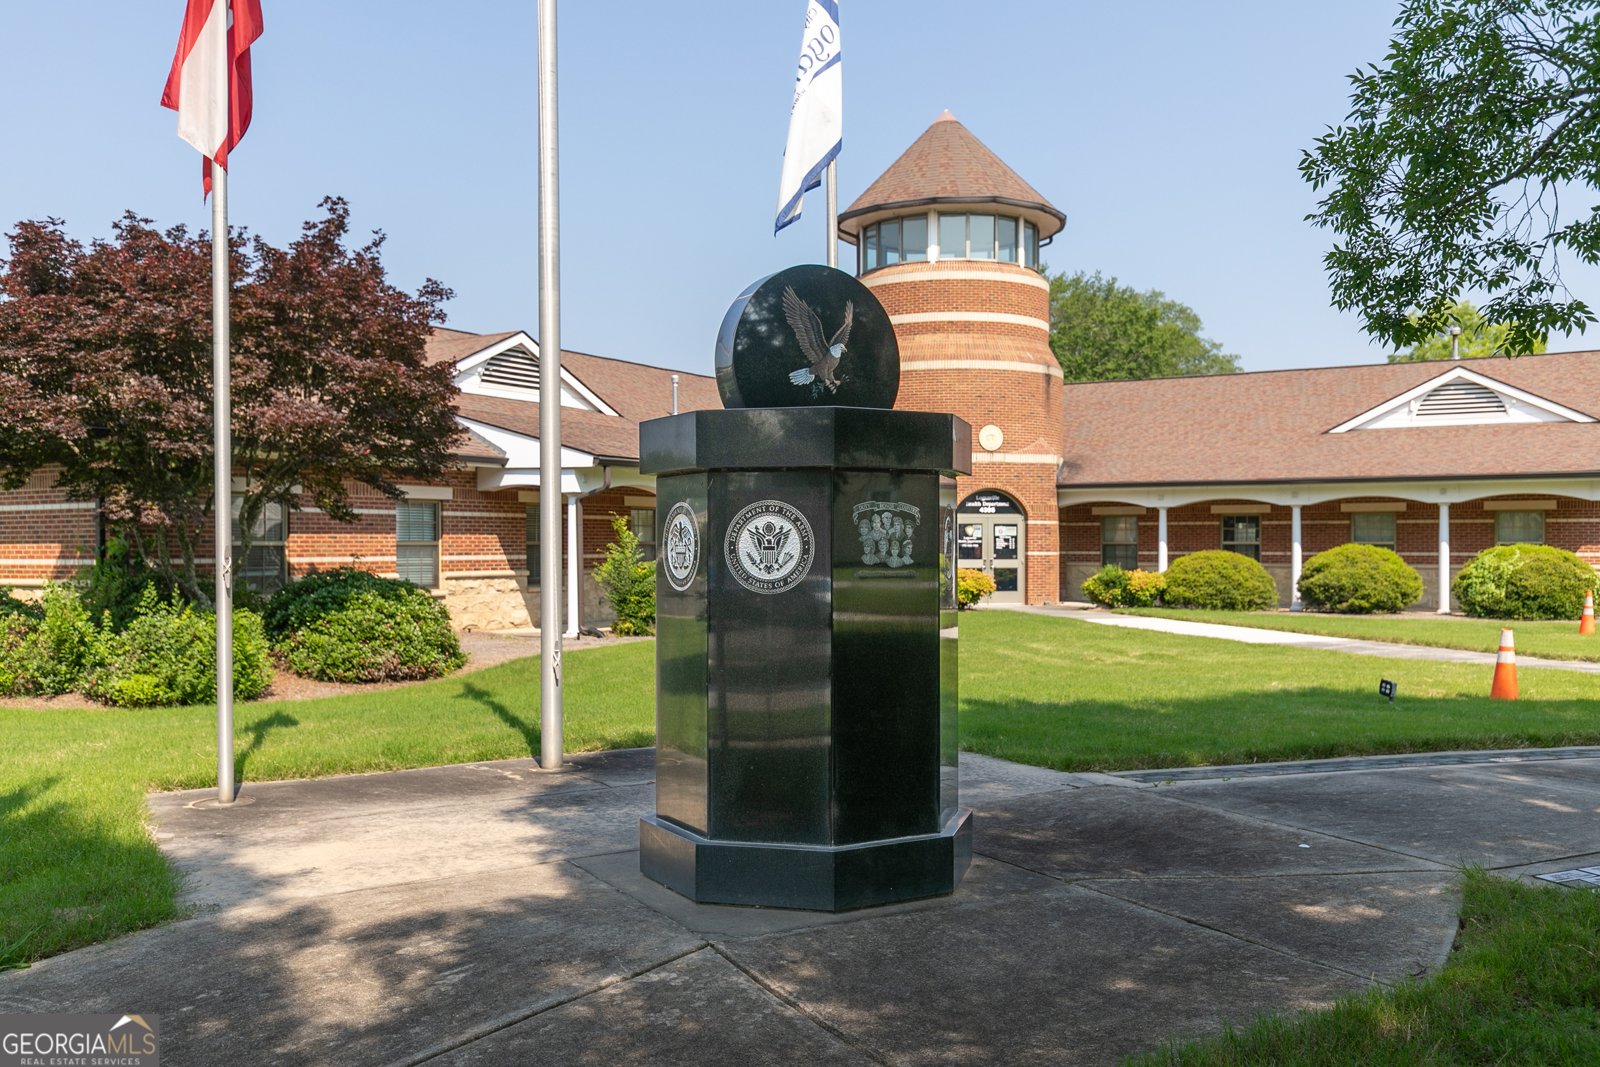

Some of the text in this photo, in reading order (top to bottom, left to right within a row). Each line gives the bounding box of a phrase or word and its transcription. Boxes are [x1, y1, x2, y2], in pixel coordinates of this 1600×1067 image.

[730, 506, 766, 542] DEPARTMENT
[782, 508, 796, 520] THE
[795, 520, 810, 542] ARMY
[730, 553, 748, 580] UNITED
[748, 579, 772, 588] STATES
[787, 554, 809, 583] AMERICA
